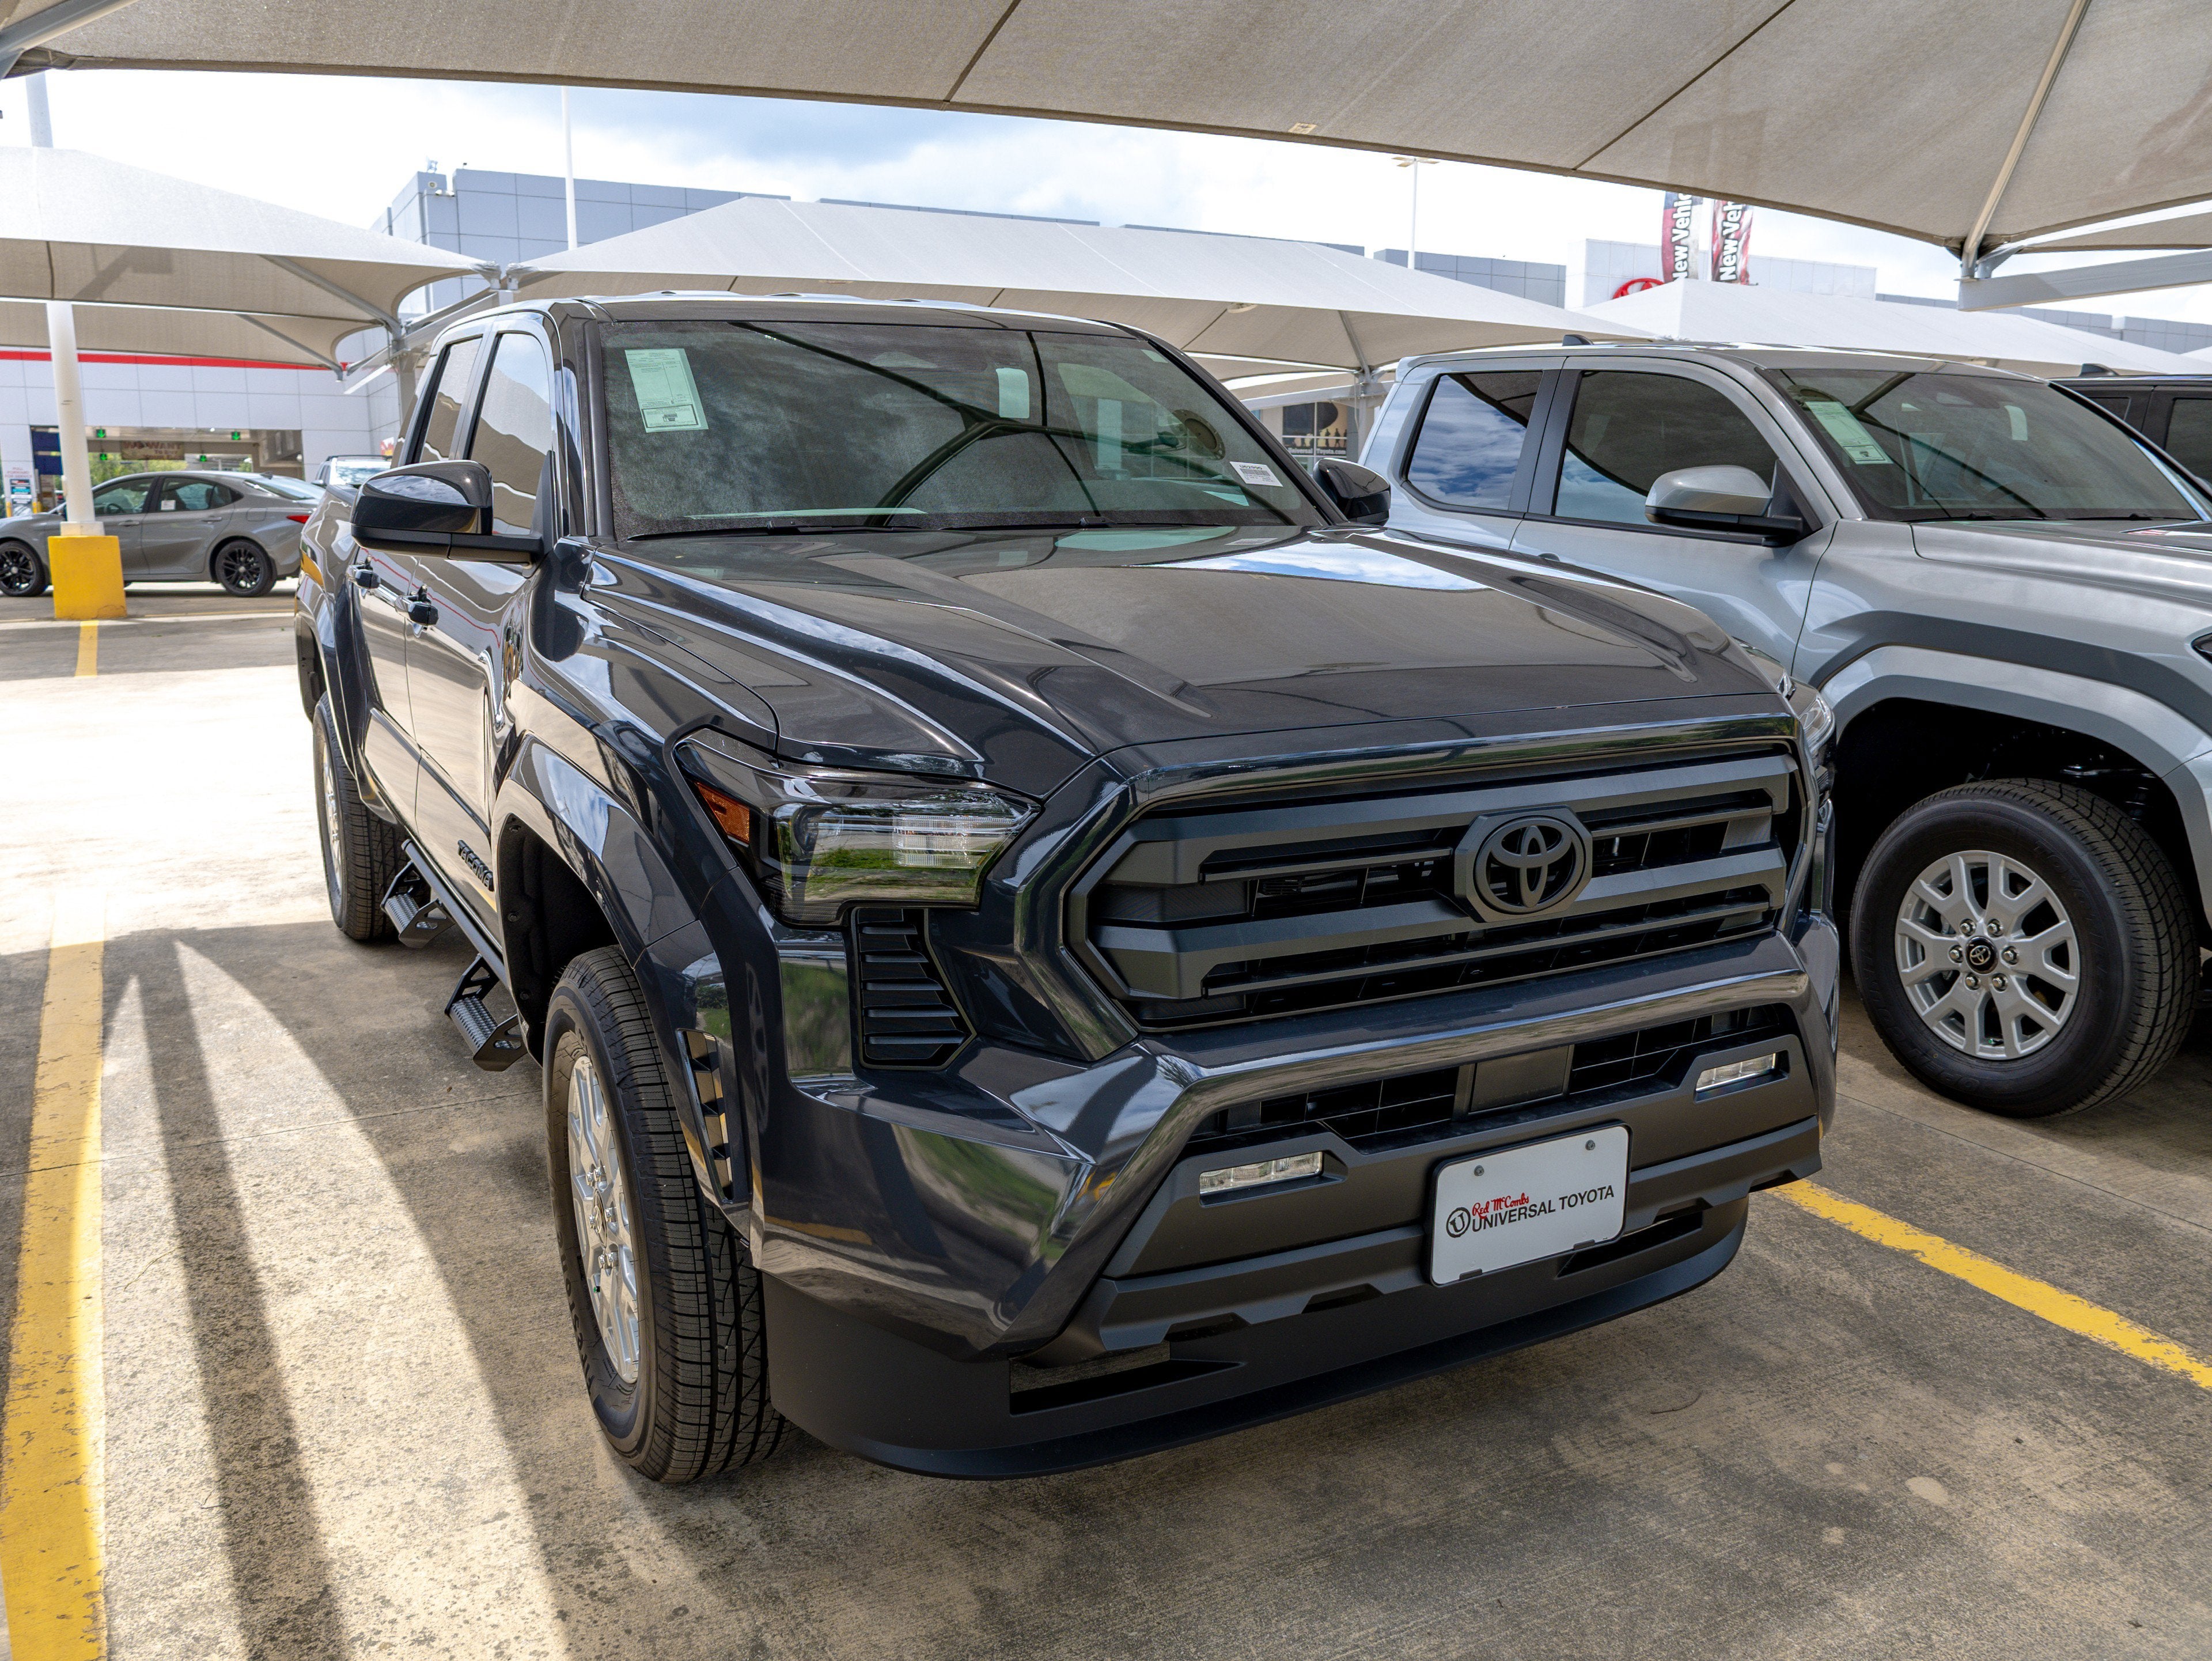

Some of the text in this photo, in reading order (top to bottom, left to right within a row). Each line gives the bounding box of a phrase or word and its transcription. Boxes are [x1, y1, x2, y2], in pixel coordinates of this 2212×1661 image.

[1719, 239, 1737, 281] New
[1472, 1192, 1529, 1220] Red McCombs
[1472, 1185, 1615, 1232] UNIVERSAL TOYOTA
